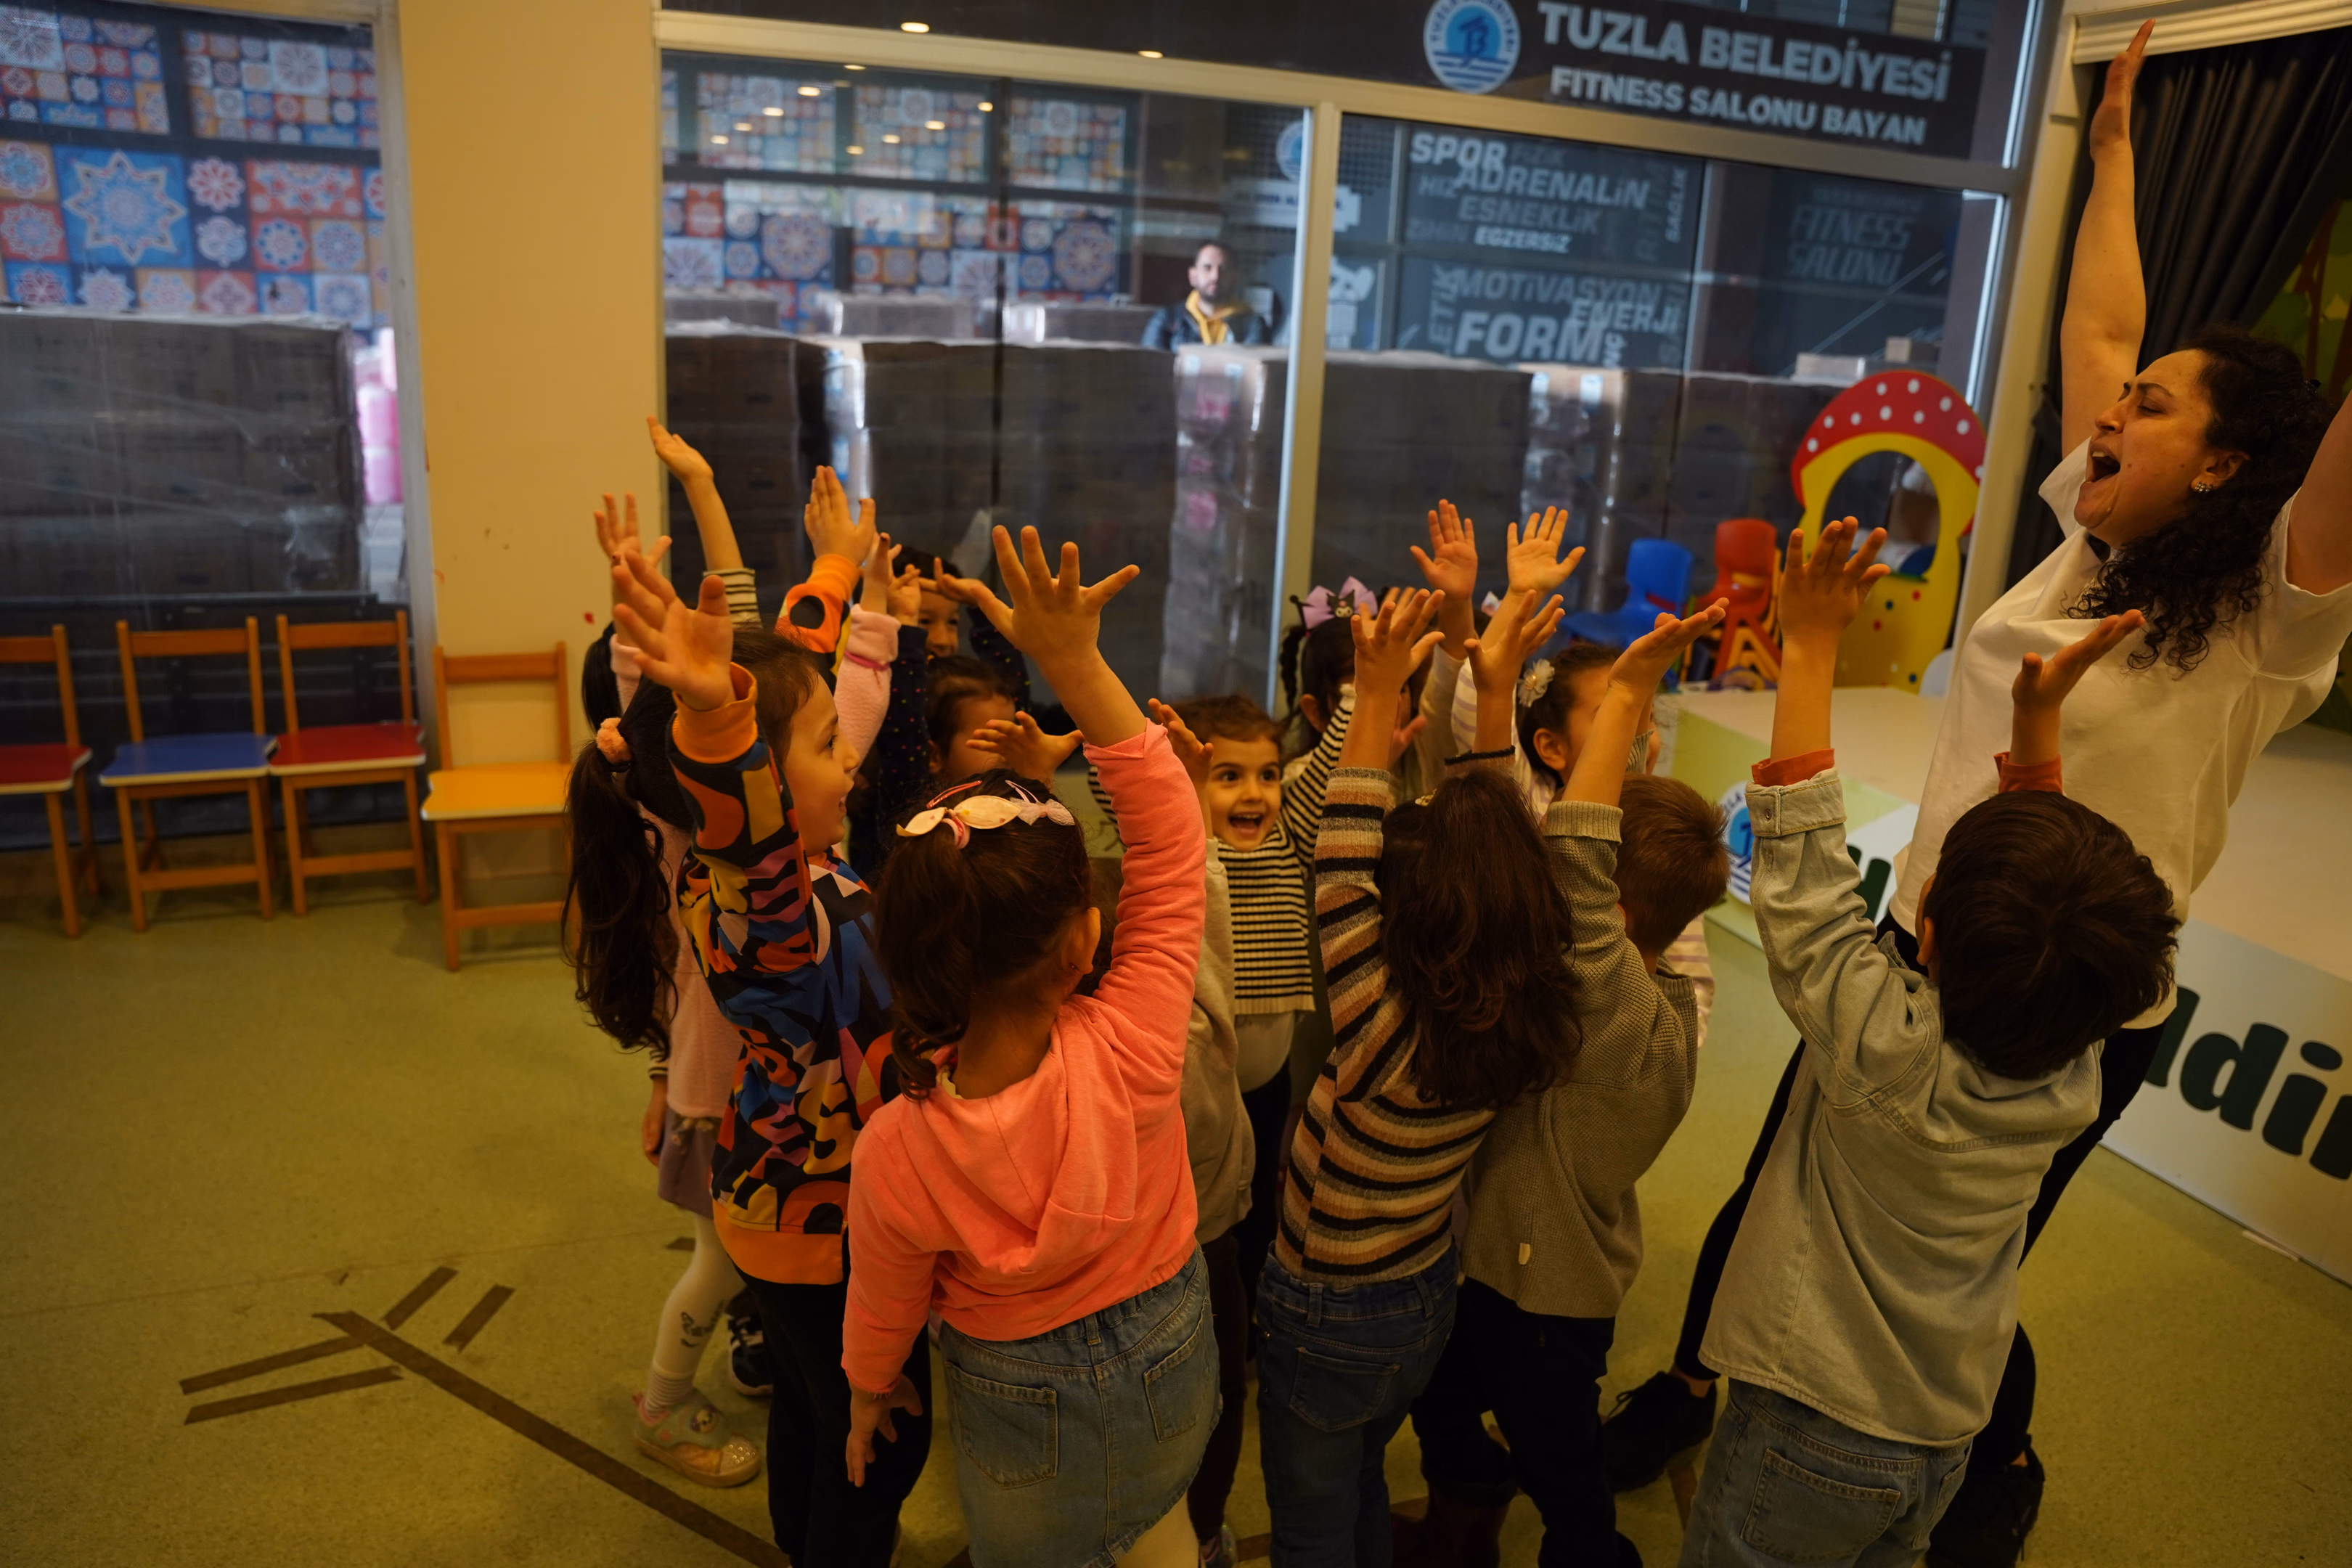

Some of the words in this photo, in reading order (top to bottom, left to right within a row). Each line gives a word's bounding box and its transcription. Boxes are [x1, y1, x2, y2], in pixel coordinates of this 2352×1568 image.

[1538, 1, 1689, 65] TUZLA
[1699, 26, 1953, 102] BELEDİYESİ
[1550, 65, 1685, 112] FITNESS
[1689, 86, 1818, 131] SALONU
[1821, 104, 1928, 145] BAYAN
[1410, 131, 1508, 170] SPOR
[1454, 309, 1610, 362] FORM
